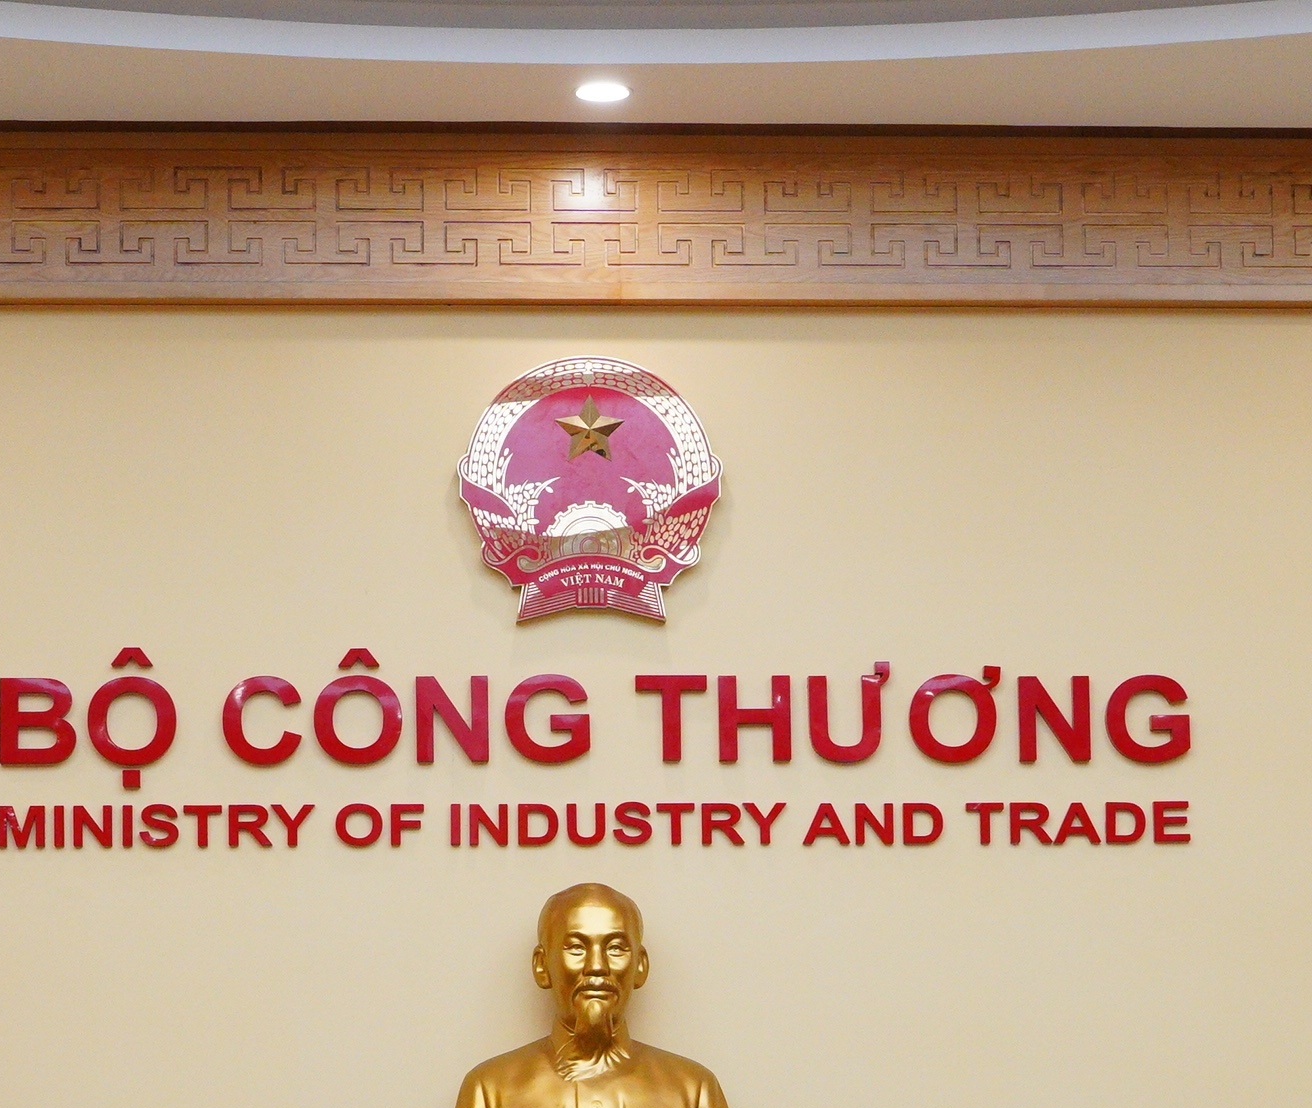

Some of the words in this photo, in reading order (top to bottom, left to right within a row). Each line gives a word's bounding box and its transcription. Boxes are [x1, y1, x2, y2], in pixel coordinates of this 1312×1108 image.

[539, 570, 559, 583] CỘNG
[590, 563, 603, 572] HỘI
[605, 563, 621, 572] CHỦ
[622, 567, 645, 581] NGHĨA
[560, 572, 592, 587] VIỆT
[595, 573, 625, 588] NAM
[0, 647, 176, 789] BỘ
[222, 648, 591, 766] CÔNG
[635, 662, 1191, 764] THƯƠNG
[334, 803, 425, 847] OF
[450, 802, 786, 846] INDUSTRY
[802, 802, 943, 845] AND
[965, 800, 1191, 844] TRADE
